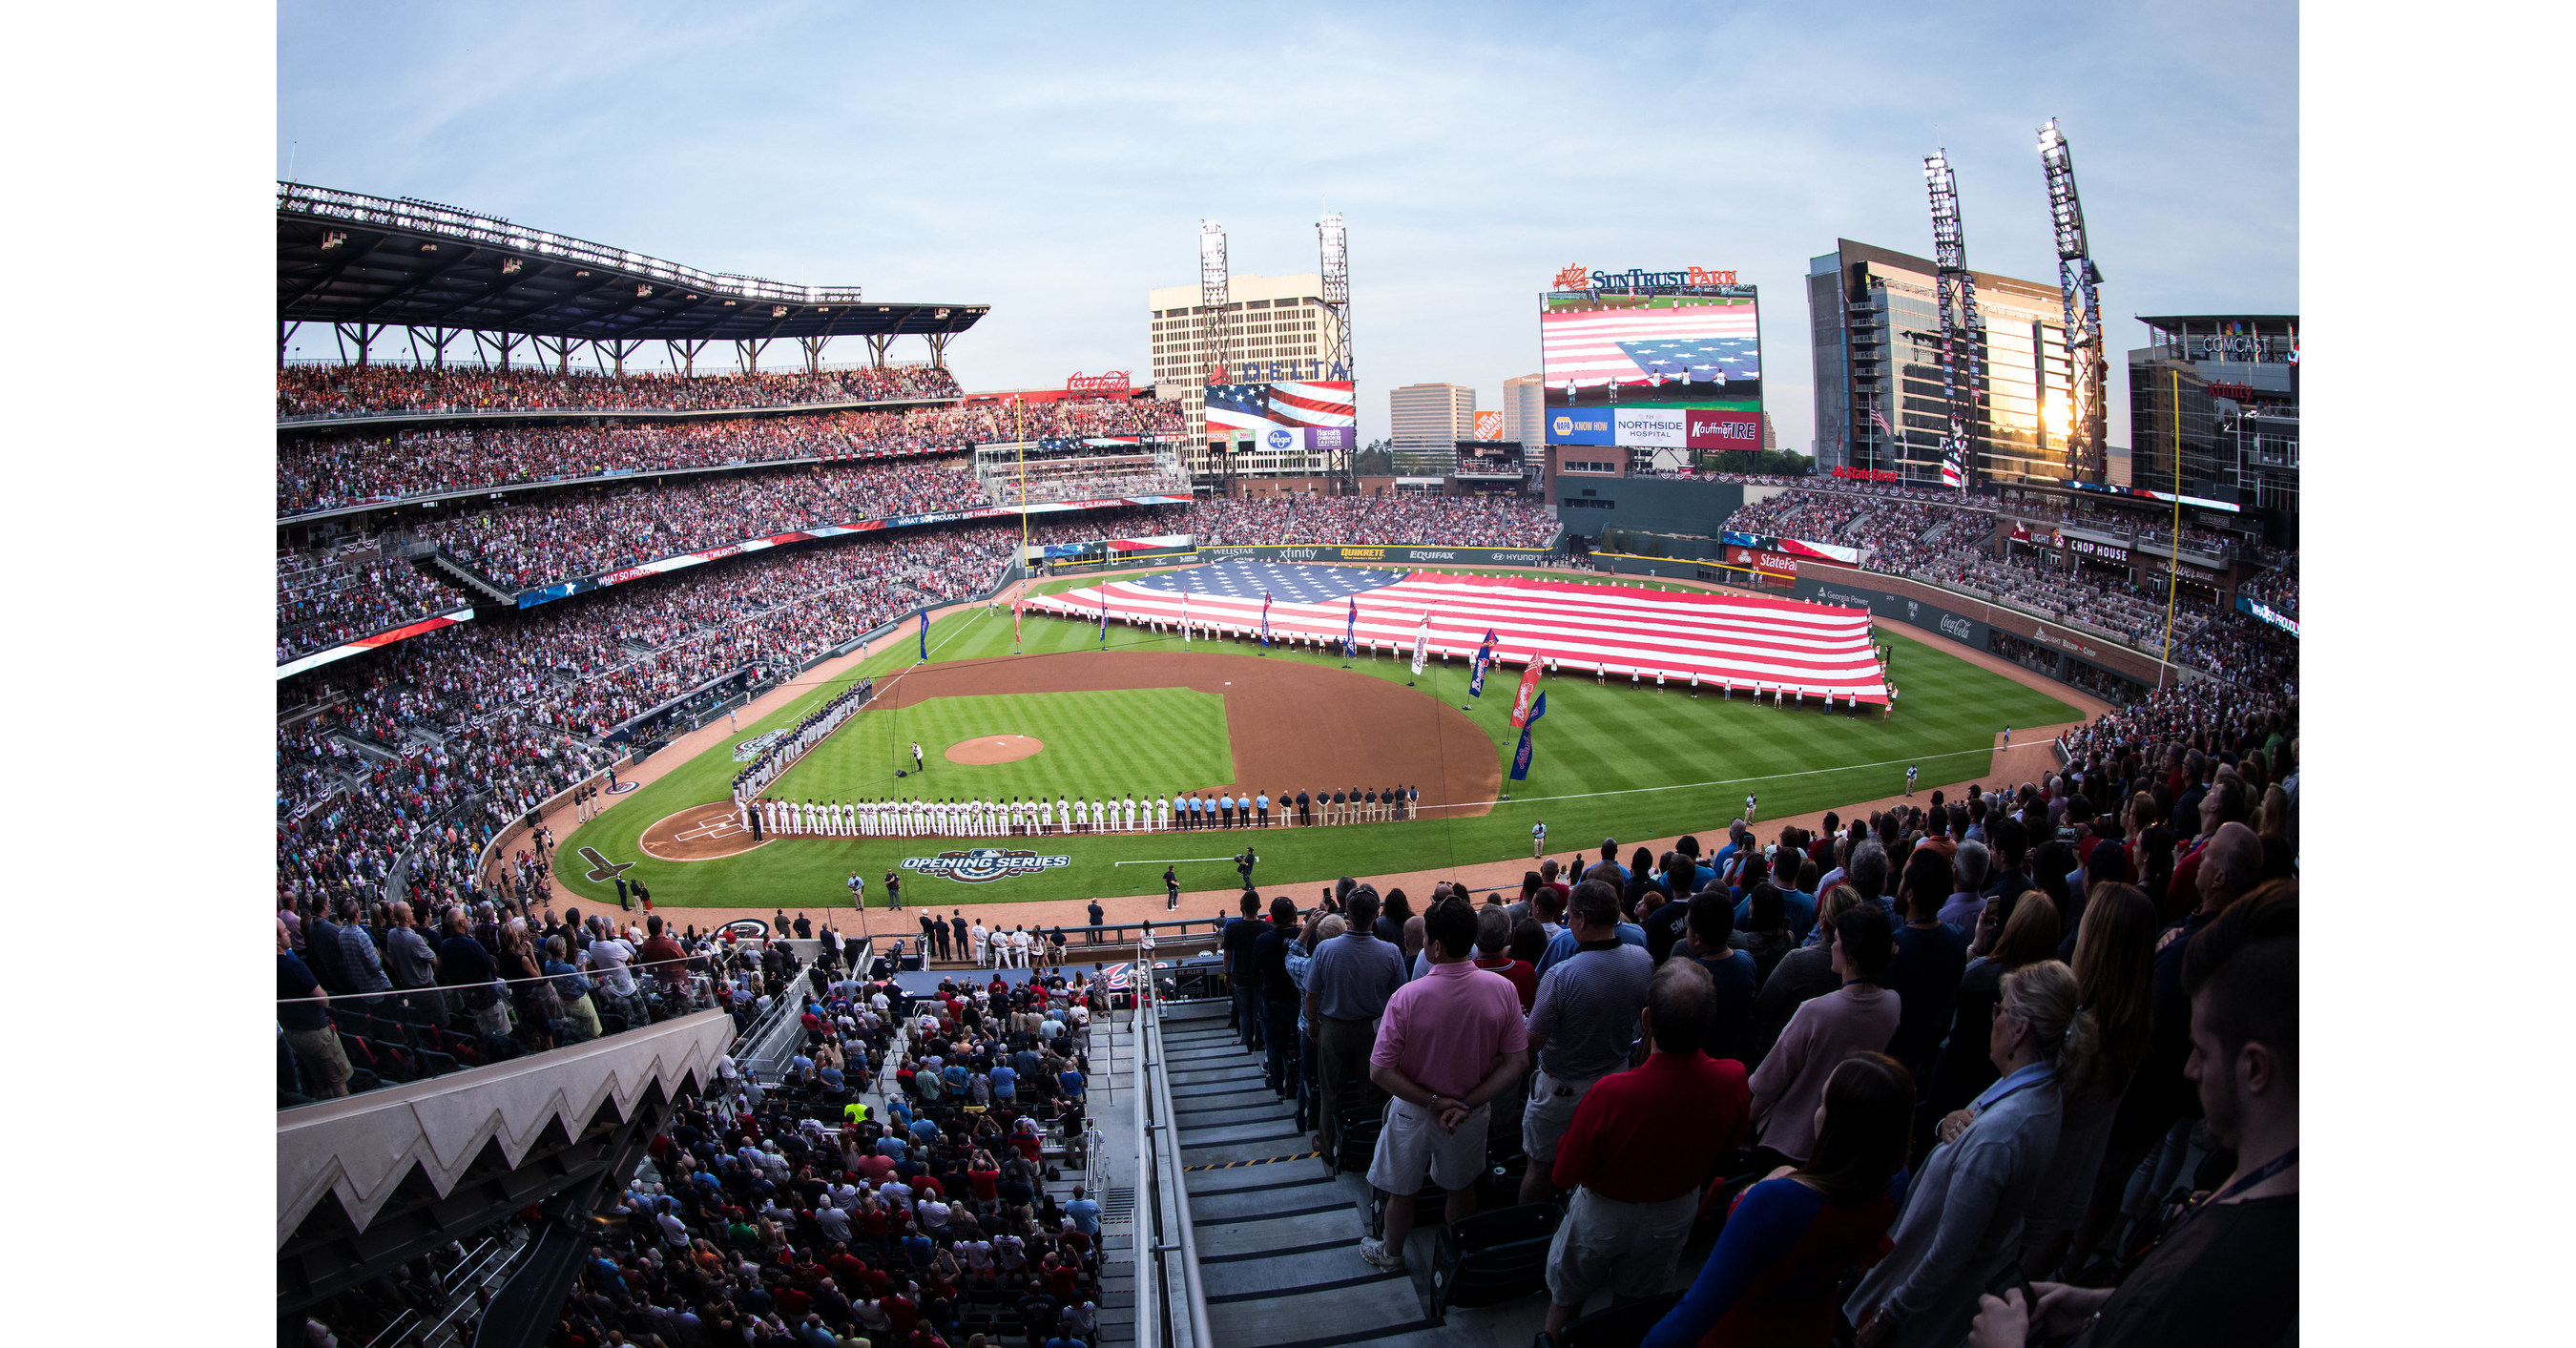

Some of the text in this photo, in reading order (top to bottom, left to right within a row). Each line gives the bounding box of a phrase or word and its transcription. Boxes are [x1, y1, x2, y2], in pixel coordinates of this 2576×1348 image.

[1688, 266, 1738, 285] PARK
[2203, 338, 2269, 353] COMCAST
[1243, 361, 1347, 382] DELTA
[1067, 370, 1132, 393] Coca-Cola
[2208, 379, 2254, 403] xfinity
[1475, 411, 1504, 439] HOME
[1476, 413, 1489, 425] THE
[1556, 421, 1609, 431] NAPA KNOW HOW
[1618, 421, 1683, 430] NORTHSIDE
[1485, 422, 1504, 439] DEPOT
[1723, 422, 1756, 440] TIRE
[1270, 431, 1291, 447] Kroger
[1846, 467, 1897, 483] StateFarm
[898, 516, 919, 527] WHAT
[963, 510, 974, 519] WE
[974, 508, 999, 518] HAILED
[2031, 532, 2050, 545] LIGHT
[1279, 547, 1318, 560] xfinity
[1340, 548, 1384, 557] QUIKRETE
[1410, 550, 1455, 560] EQUIFAX
[2071, 539, 2128, 561] CHOP HOUSE
[597, 573, 618, 586] WHAT
[619, 570, 629, 581] SO
[2196, 570, 2214, 582] BULLET
[1827, 591, 1869, 606] Georgia Power
[1940, 613, 1972, 639] Coca-Cola
[1471, 659, 1484, 693] Braves
[1513, 683, 1527, 721] Braves
[904, 856, 1068, 868] OPENING SERIES
